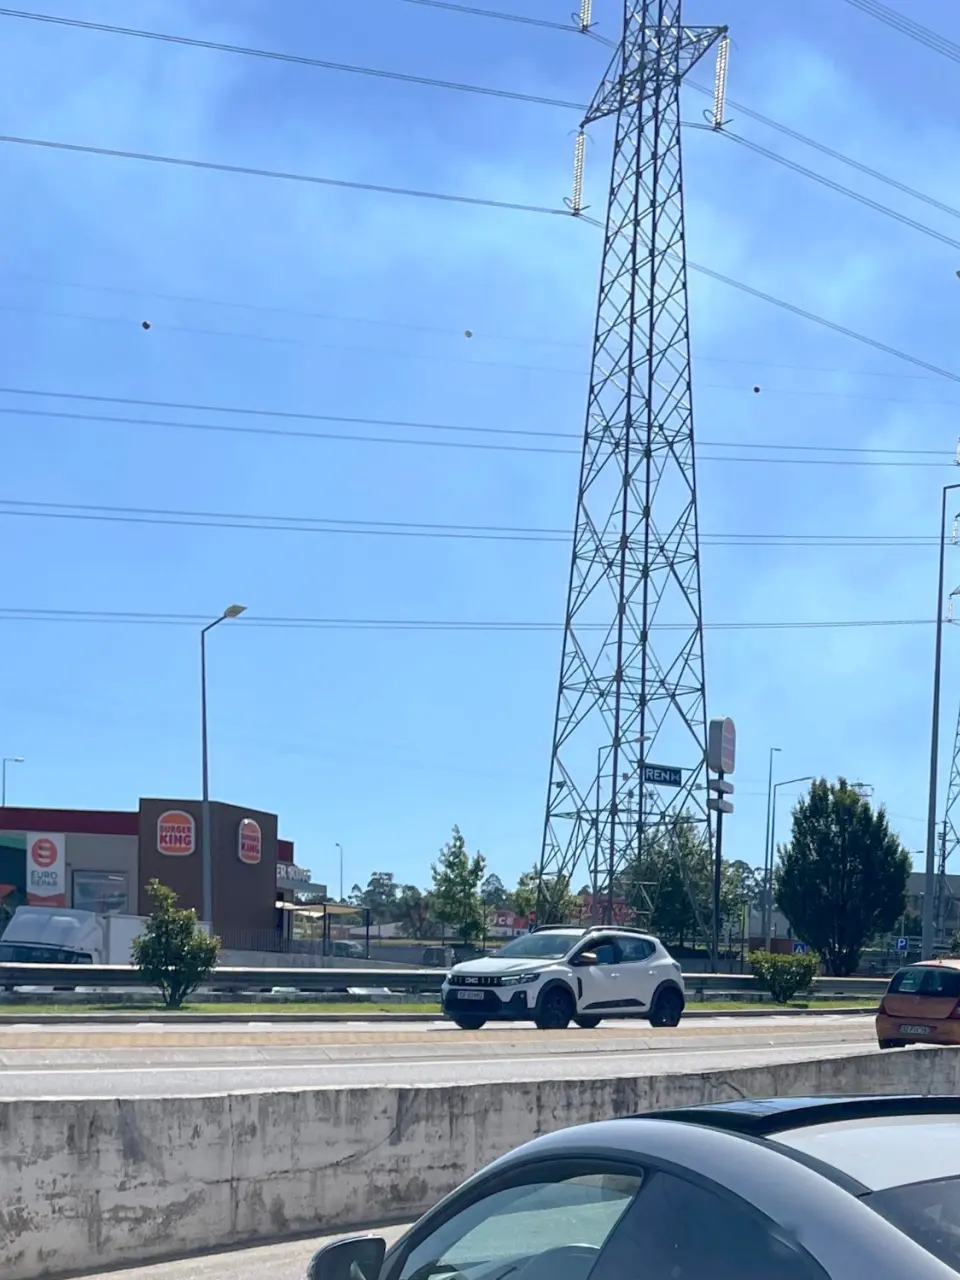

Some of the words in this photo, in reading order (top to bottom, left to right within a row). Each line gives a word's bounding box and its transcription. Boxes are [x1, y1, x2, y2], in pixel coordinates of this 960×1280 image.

[646, 768, 670, 781] REN
[160, 834, 191, 845] KING
[31, 871, 58, 880] EURO
